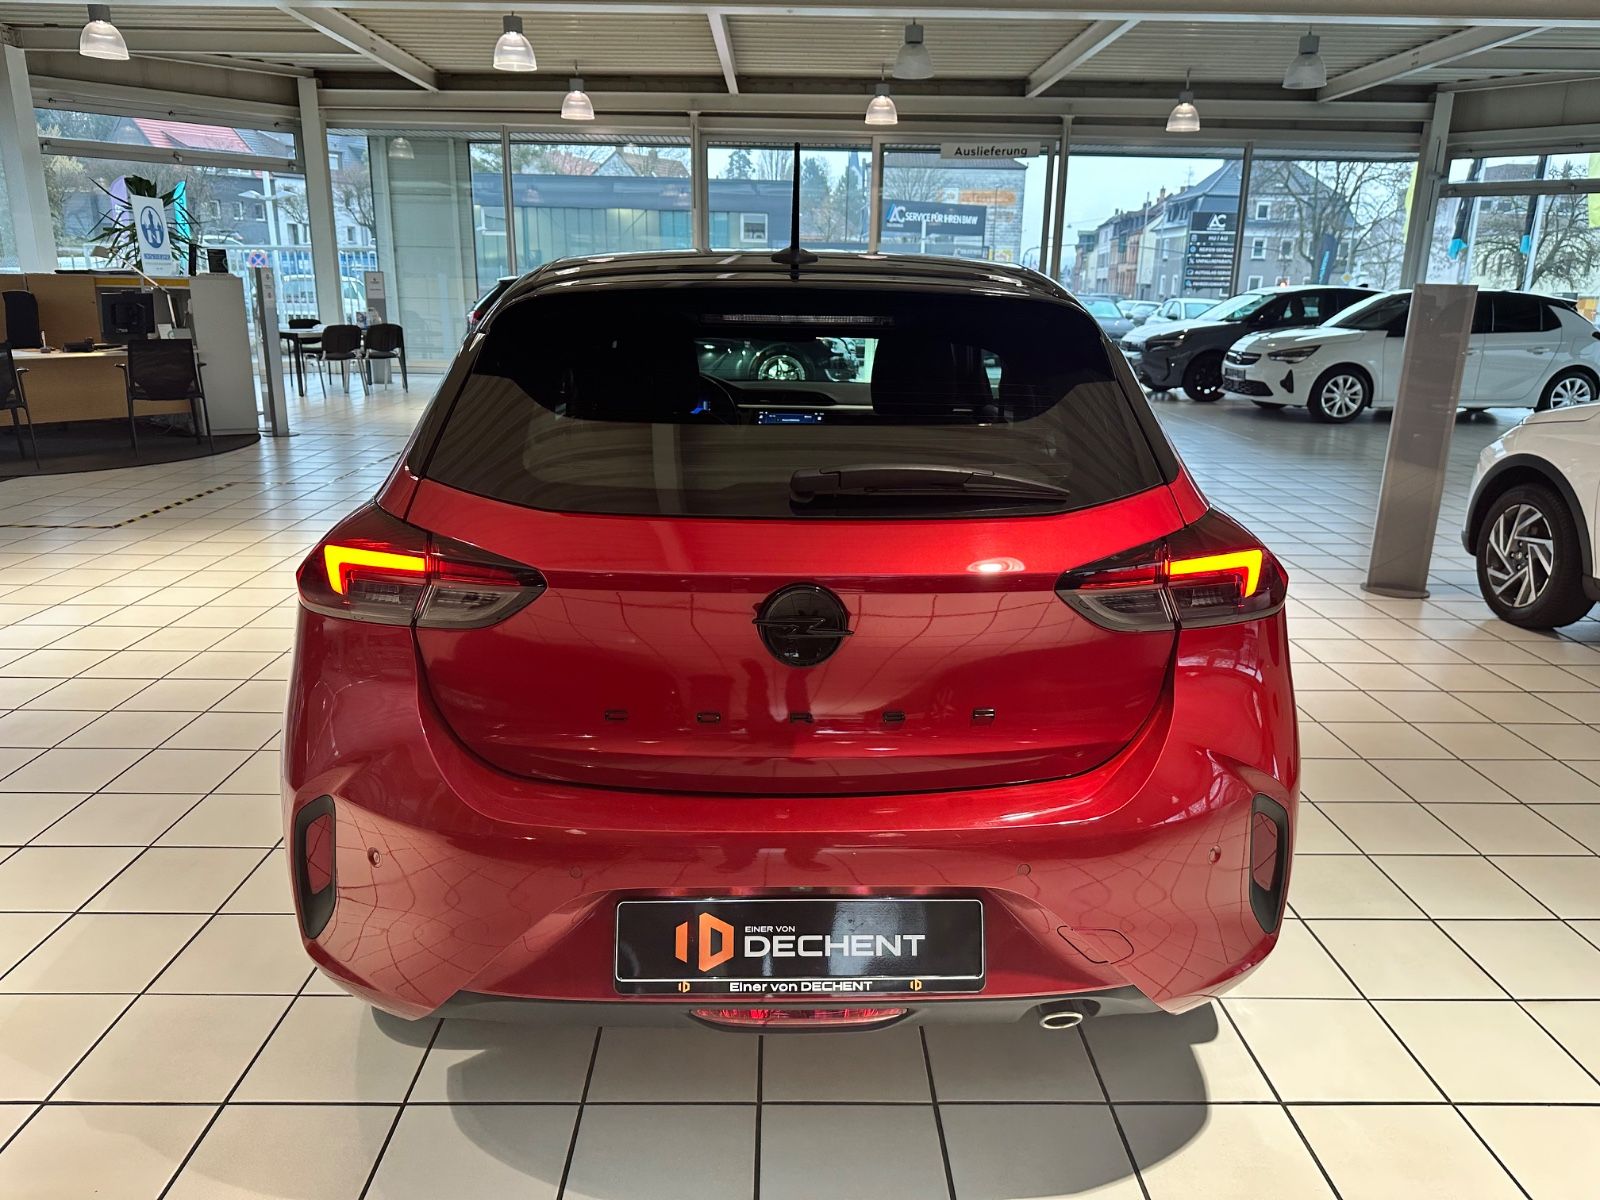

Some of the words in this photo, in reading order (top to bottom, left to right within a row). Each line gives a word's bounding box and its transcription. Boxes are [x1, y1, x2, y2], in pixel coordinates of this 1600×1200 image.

[954, 146, 1028, 156] Auslieferung
[905, 211, 931, 222] SERVICE
[931, 212, 944, 223] FÜR
[962, 215, 978, 225] BMW
[744, 934, 926, 958] DECHENT
[729, 981, 767, 992] Einer
[770, 982, 798, 992] von
[800, 981, 872, 992] DECHENT
